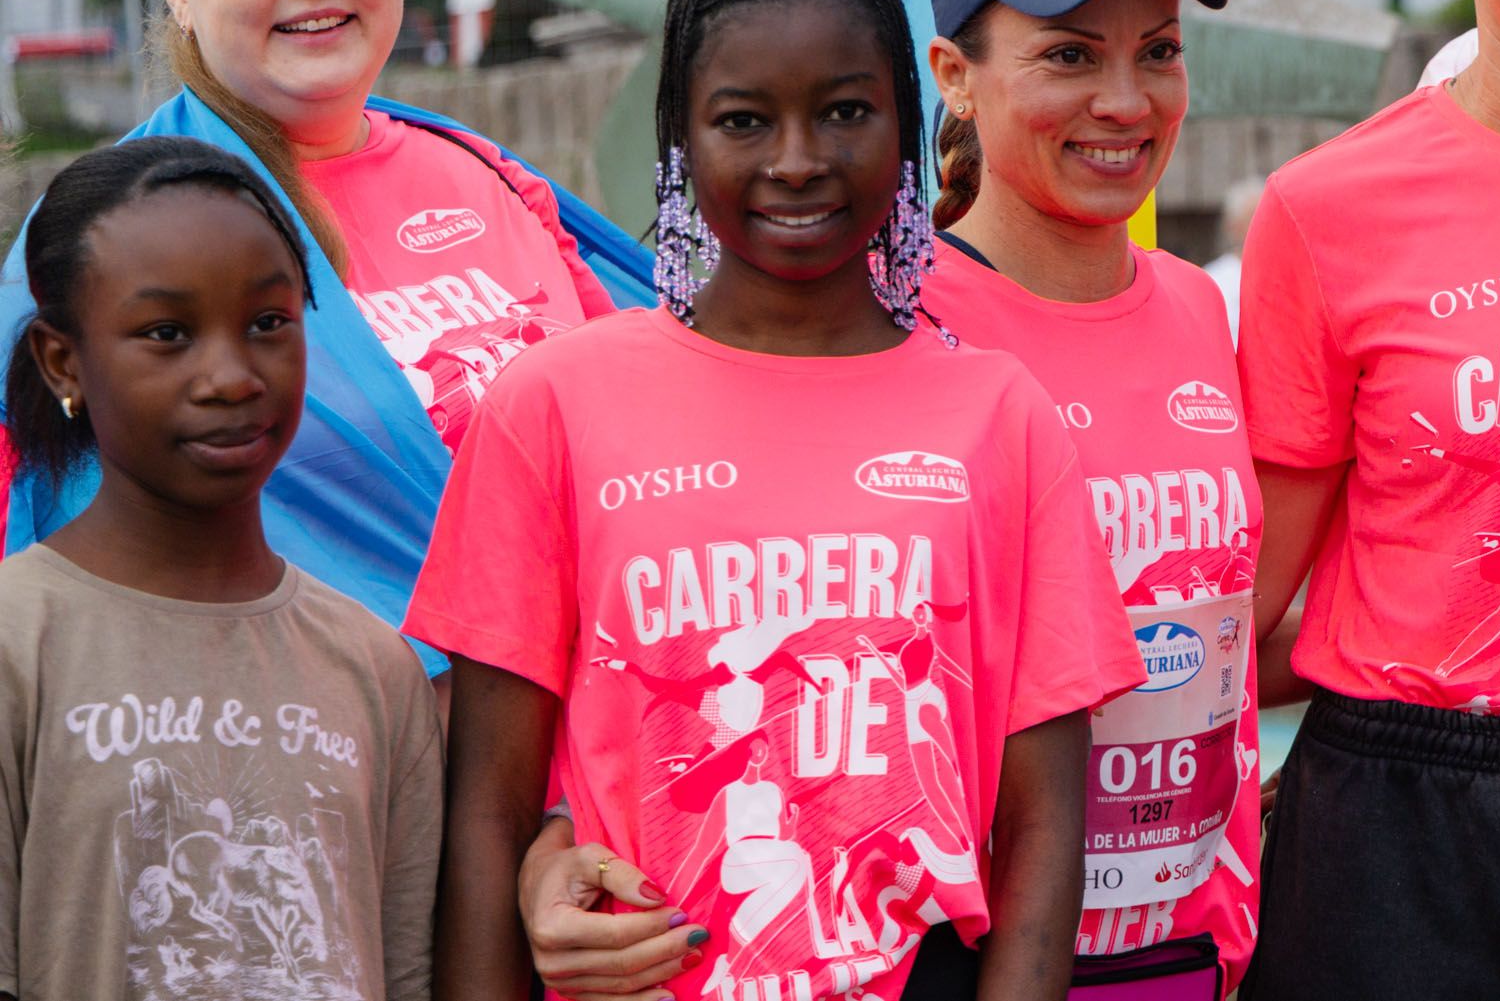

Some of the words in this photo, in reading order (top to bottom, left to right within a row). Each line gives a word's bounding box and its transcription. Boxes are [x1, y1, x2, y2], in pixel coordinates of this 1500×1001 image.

[405, 217, 481, 248] ASTURIANA
[599, 460, 738, 511] OYSHO
[866, 467, 967, 495] ASTURIANA
[622, 534, 933, 646] CARRERA
[65, 693, 204, 762] Wild
[214, 699, 261, 747] &
[276, 703, 359, 768] Free
[792, 652, 897, 779] DE
[1099, 739, 1197, 794] 016
[1094, 833, 1113, 849] DE
[1118, 832, 1136, 849] LA
[1140, 826, 1180, 846] MUJER
[1189, 823, 1196, 838] A
[1129, 800, 1173, 825] 1297
